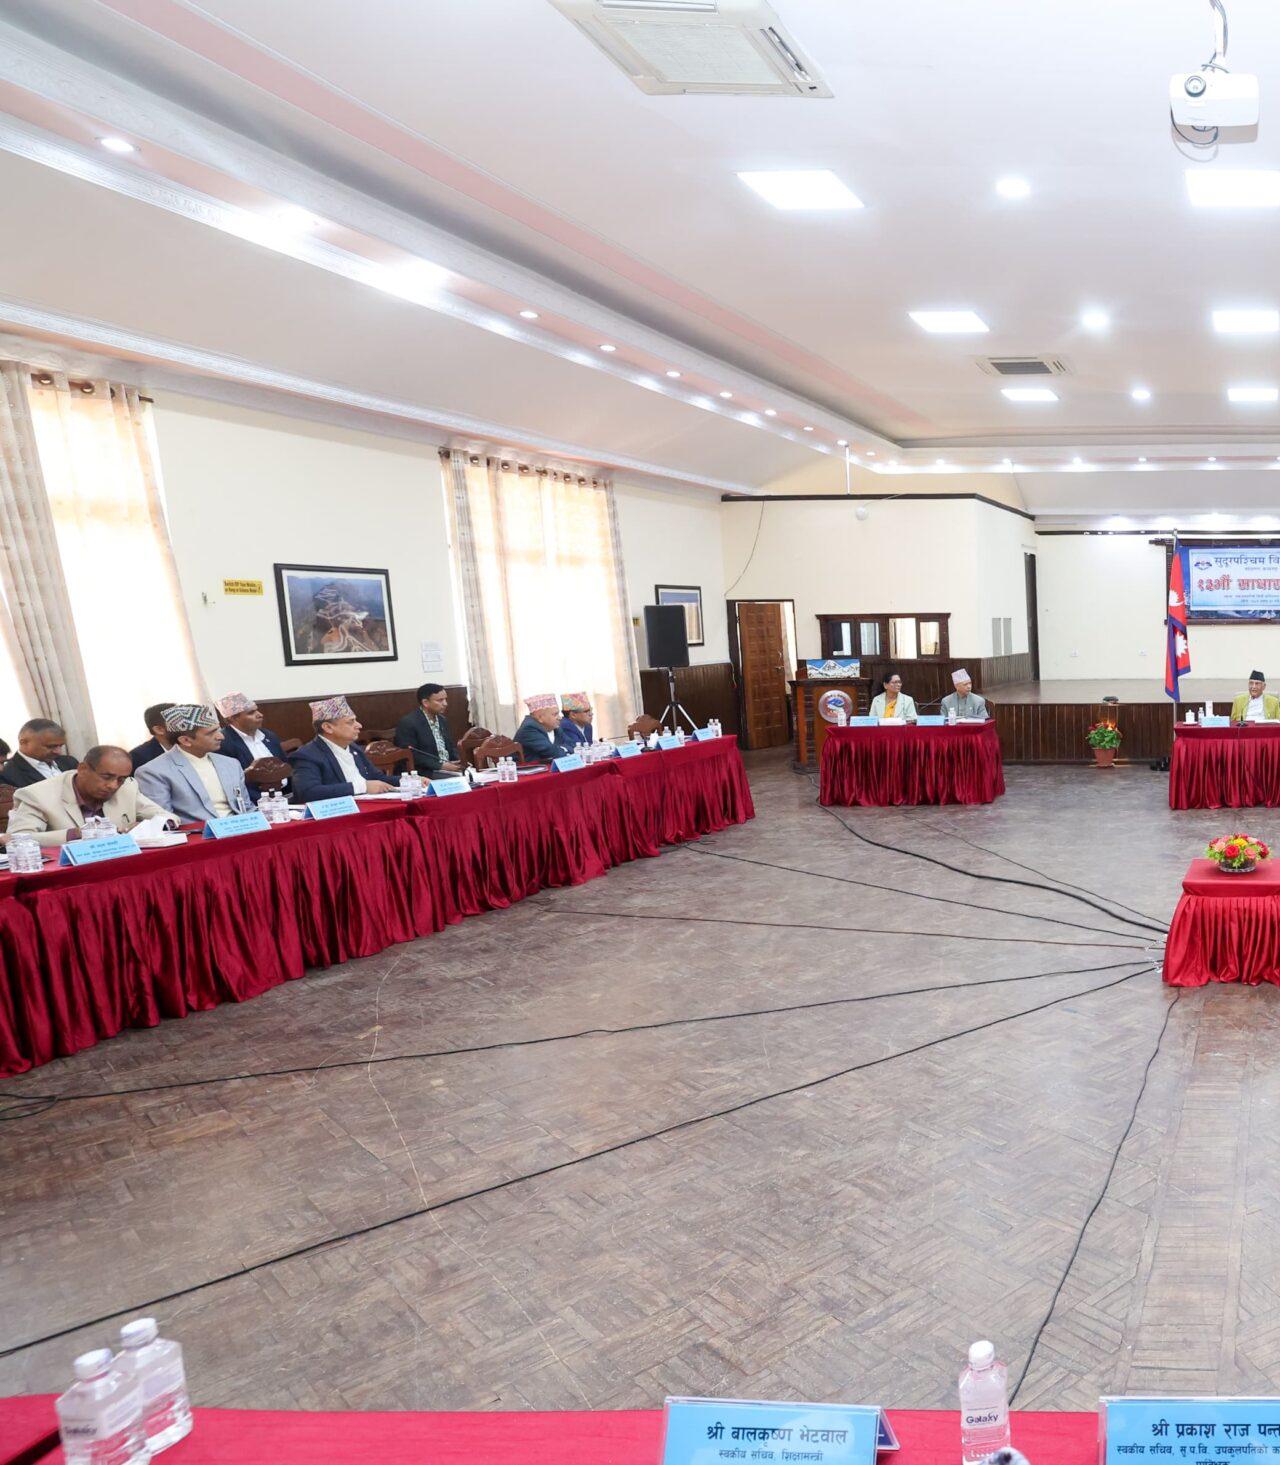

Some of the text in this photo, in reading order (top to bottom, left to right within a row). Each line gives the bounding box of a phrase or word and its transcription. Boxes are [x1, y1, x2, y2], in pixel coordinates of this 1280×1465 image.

[966, 1411, 999, 1425] Galaxy
[706, 1422, 725, 1440] श्री
[799, 1425, 848, 1445] भेटवाल
[1152, 1419, 1169, 1437] श्री
[1175, 1423, 1216, 1438] प्रकाश
[1223, 1423, 1251, 1439] राज
[1117, 1443, 1145, 1454] स्वकीय
